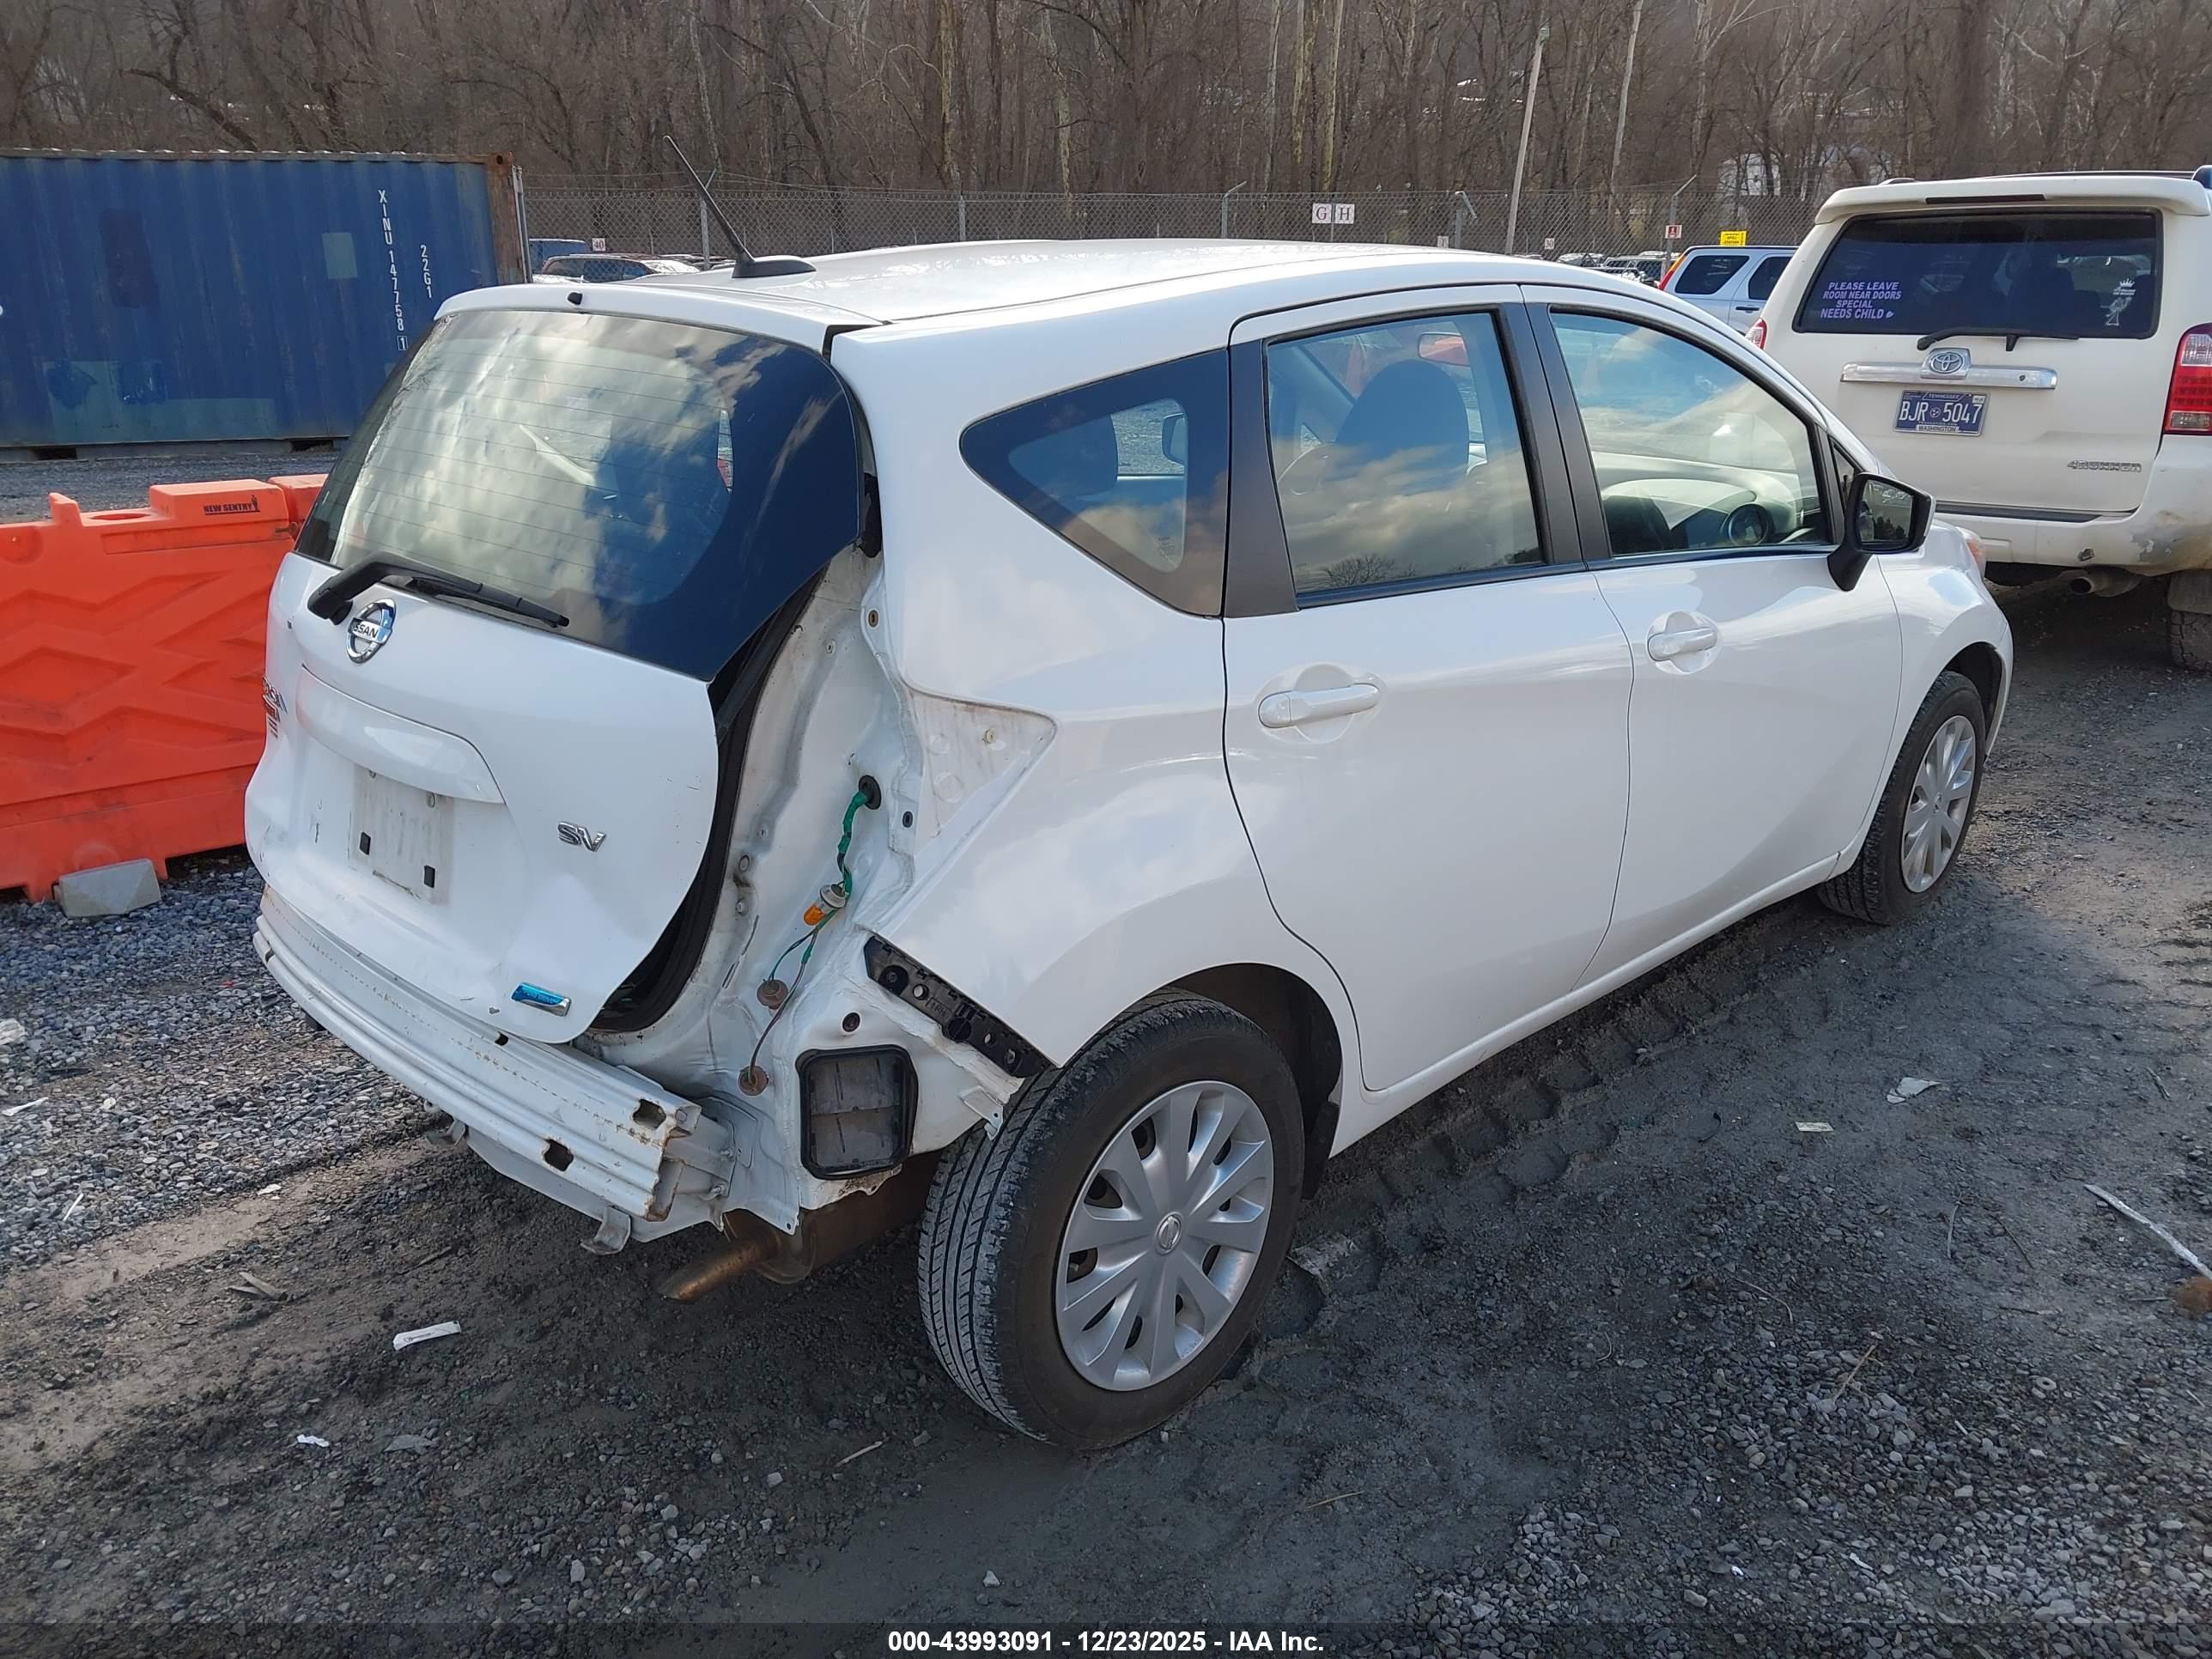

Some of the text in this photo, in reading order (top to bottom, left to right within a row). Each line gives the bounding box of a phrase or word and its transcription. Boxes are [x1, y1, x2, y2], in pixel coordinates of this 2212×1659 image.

[1316, 206, 1328, 221] G
[1339, 206, 1351, 221] H
[378, 190, 392, 245] XINU
[389, 250, 404, 331] 147758
[421, 245, 432, 298] 22G1
[1828, 282, 1899, 290] PLEASE LEAVE
[1823, 290, 1902, 300] ROOM NEAR DOORS
[1836, 299, 1873, 308] SPECIAL
[1820, 308, 1884, 319] NEEDS CHILD
[1899, 401, 1983, 424] BJR 5047
[557, 821, 606, 852] SV
